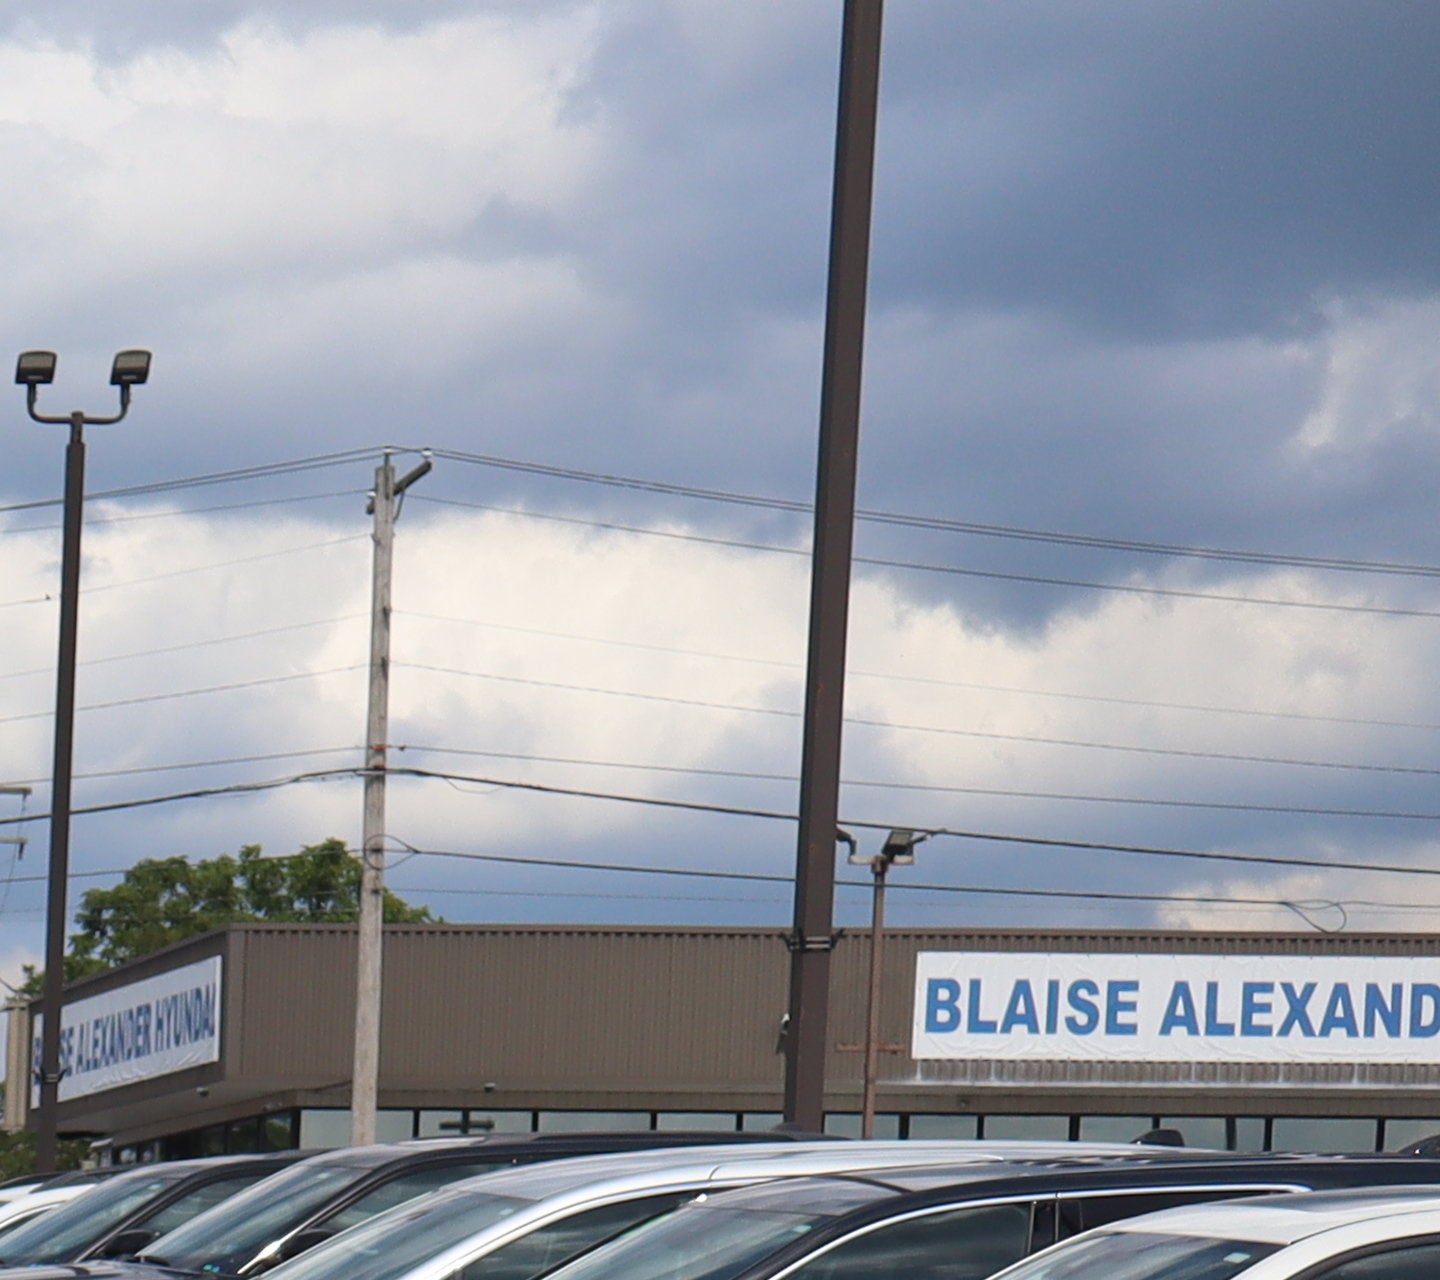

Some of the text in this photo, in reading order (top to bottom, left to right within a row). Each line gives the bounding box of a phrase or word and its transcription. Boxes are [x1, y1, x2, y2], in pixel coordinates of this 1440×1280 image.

[75, 1004, 152, 1073] ALEXANDER
[155, 983, 216, 1053] HYUNDAI
[924, 978, 1440, 1038] BLAISE ALEXAND
